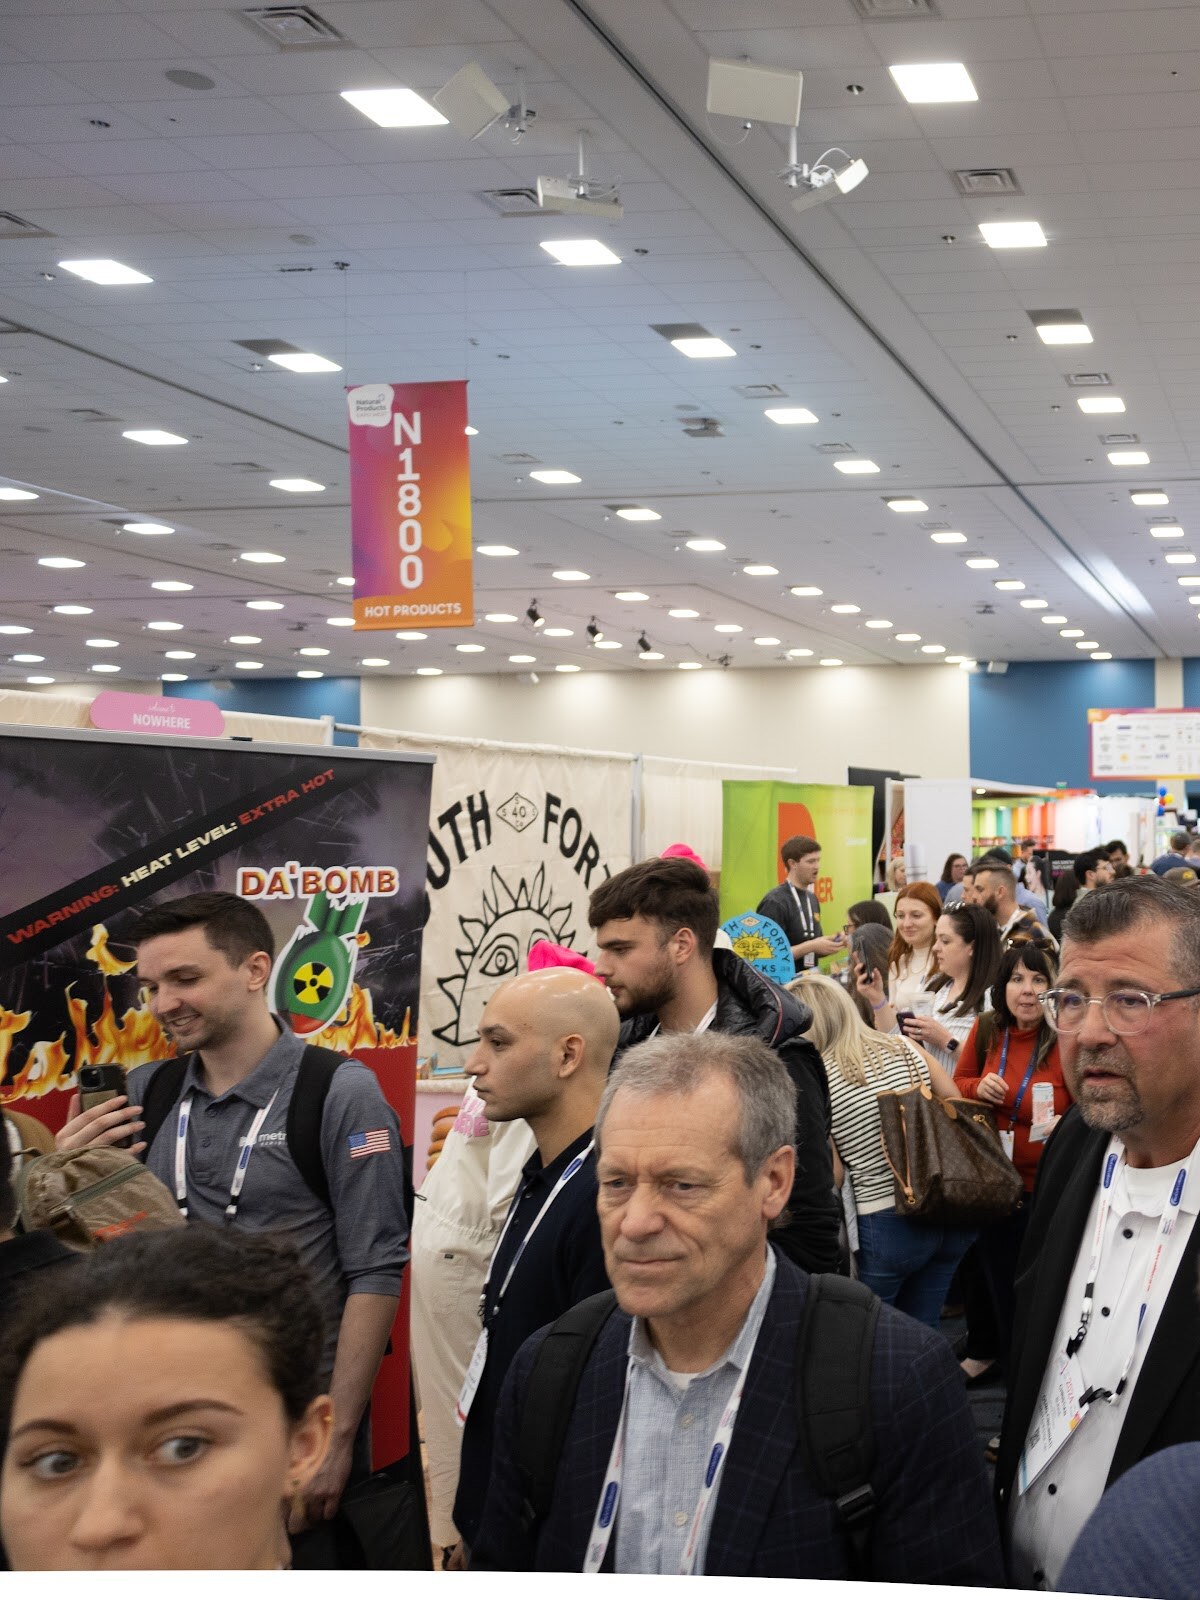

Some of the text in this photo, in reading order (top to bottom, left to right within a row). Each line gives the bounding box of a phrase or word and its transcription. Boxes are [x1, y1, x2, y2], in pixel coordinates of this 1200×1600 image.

[393, 411, 424, 589] N1800
[365, 602, 462, 618] HOT PRODUCTS
[133, 713, 190, 729] NOWHERE
[512, 806, 526, 818] 40
[6, 768, 336, 945] WARNING: HEAT LEVEL: EXTRA HOT
[543, 791, 610, 889] FOR
[240, 863, 397, 897] DA'BOMB
[762, 921, 790, 962] FORTY
